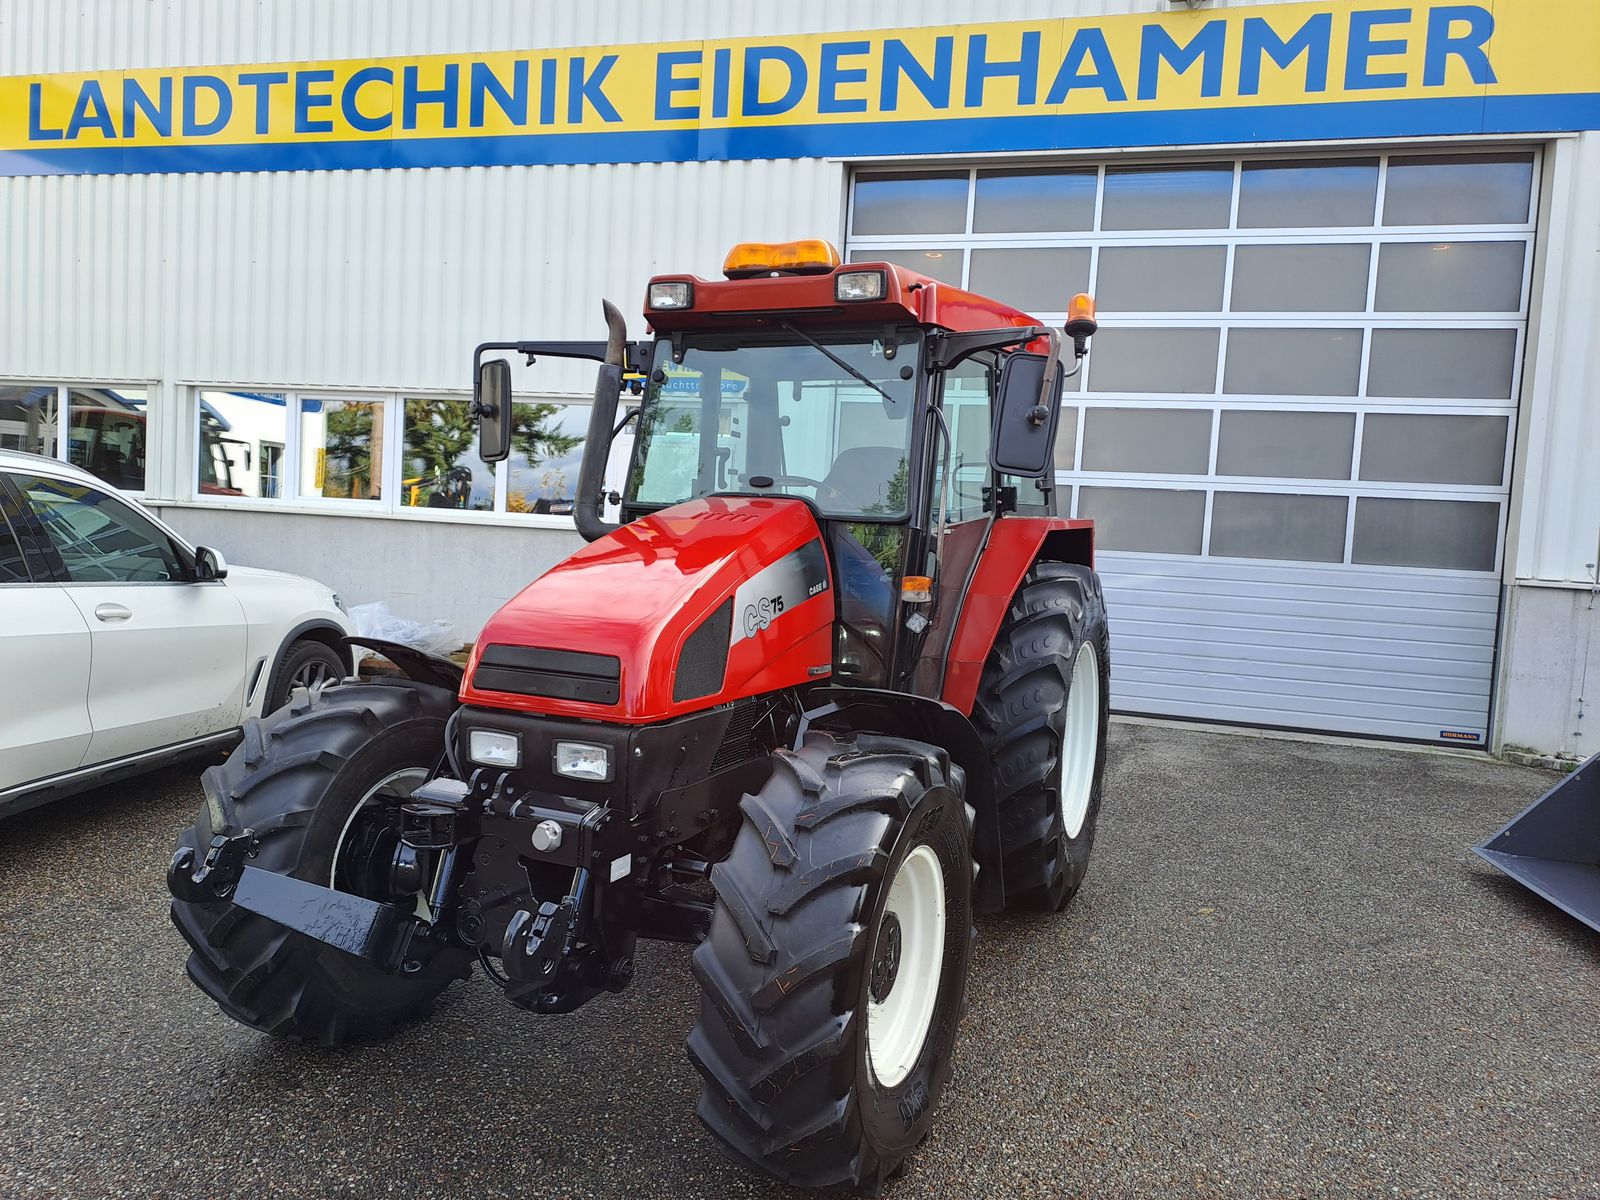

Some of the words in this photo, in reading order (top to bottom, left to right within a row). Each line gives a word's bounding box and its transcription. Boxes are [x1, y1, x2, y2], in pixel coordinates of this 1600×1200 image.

[28, 54, 623, 141] LANDTECHNIK
[653, 4, 1498, 119] EIDENHAMMER
[808, 582, 823, 596] CASE
